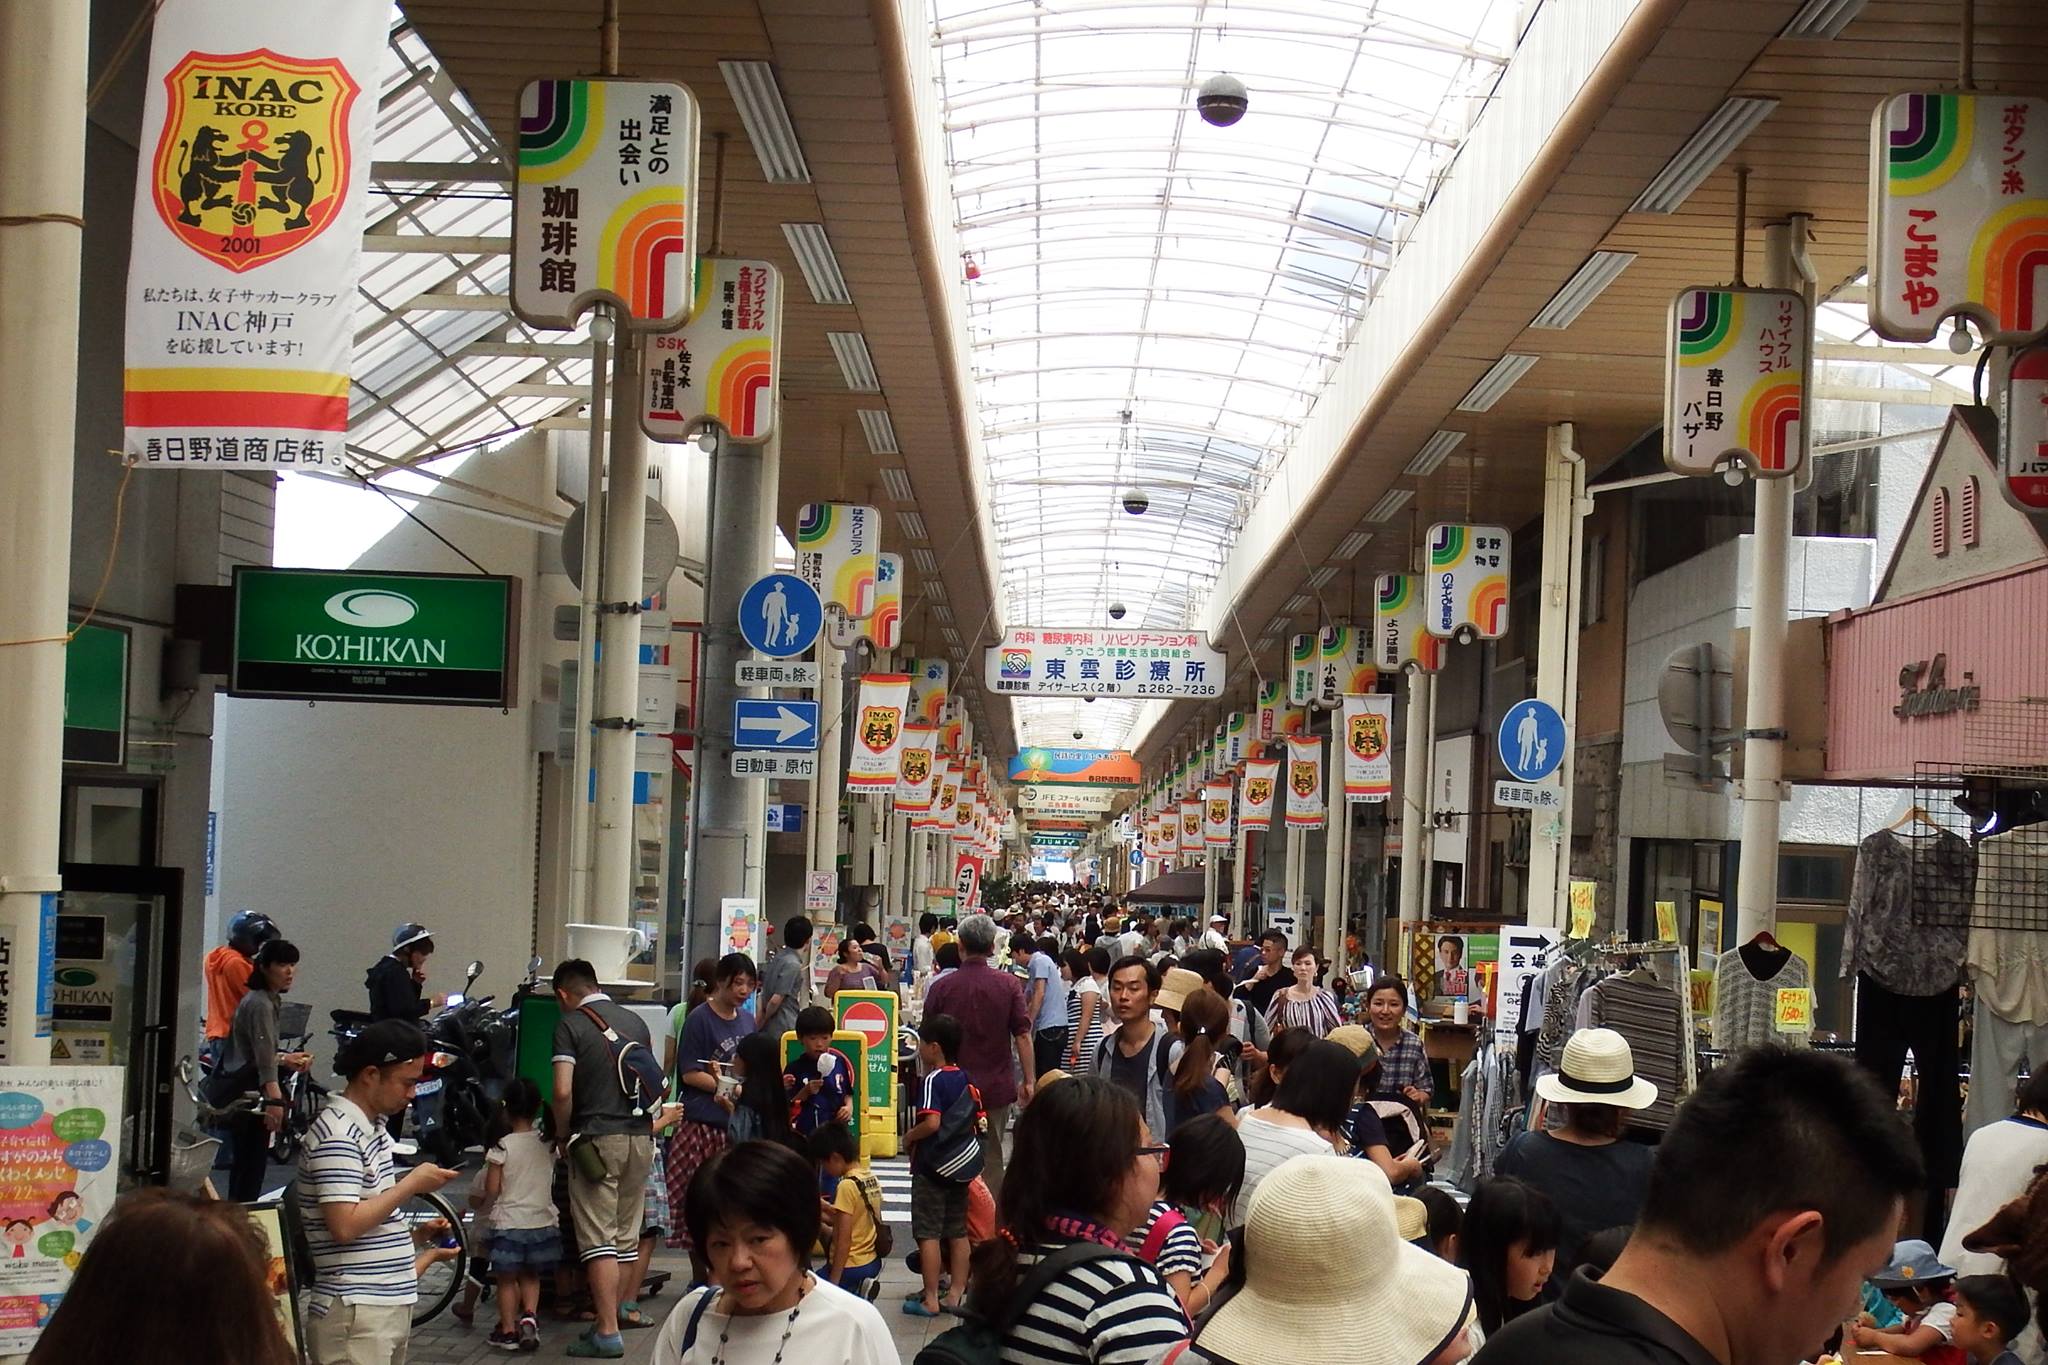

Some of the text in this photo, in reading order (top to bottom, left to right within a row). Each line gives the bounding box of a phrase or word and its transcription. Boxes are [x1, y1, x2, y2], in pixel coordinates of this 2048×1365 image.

[193, 75, 324, 105] INAC
[214, 103, 297, 119] KOBE
[649, 94, 671, 174] 満足との
[619, 119, 642, 186] 出会い
[220, 236, 261, 256] 2001
[539, 185, 578, 293] 珈琲館
[1902, 209, 1939, 315] こまや
[143, 287, 337, 308] 私たちは、女子サッカークラブ
[752, 267, 767, 332] フジサイクル
[177, 310, 294, 335] INAC神戸
[1778, 301, 1793, 370] リサイクル
[166, 338, 304, 358] を応援しています!
[656, 337, 688, 350] SSK
[1759, 327, 1775, 373] ハウス
[677, 351, 692, 388] 佐々木
[660, 358, 676, 410] 自転車店
[1705, 368, 1725, 431] 春日野
[1683, 401, 1703, 458] バザー
[147, 437, 324, 465] 春日野道商店街
[851, 508, 864, 555] はなクリニック
[1015, 632, 1035, 643] 内科
[1101, 633, 1198, 647] リハビリテーション科
[1065, 647, 1191, 659] ろっこう医療生活協同組合
[740, 667, 816, 682] 軽車両を除く
[1045, 658, 1206, 682] 東雲診療所
[1150, 684, 1216, 695] 262-7236
[736, 758, 813, 775] 自動車・原付
[1511, 953, 1546, 969] 会場
